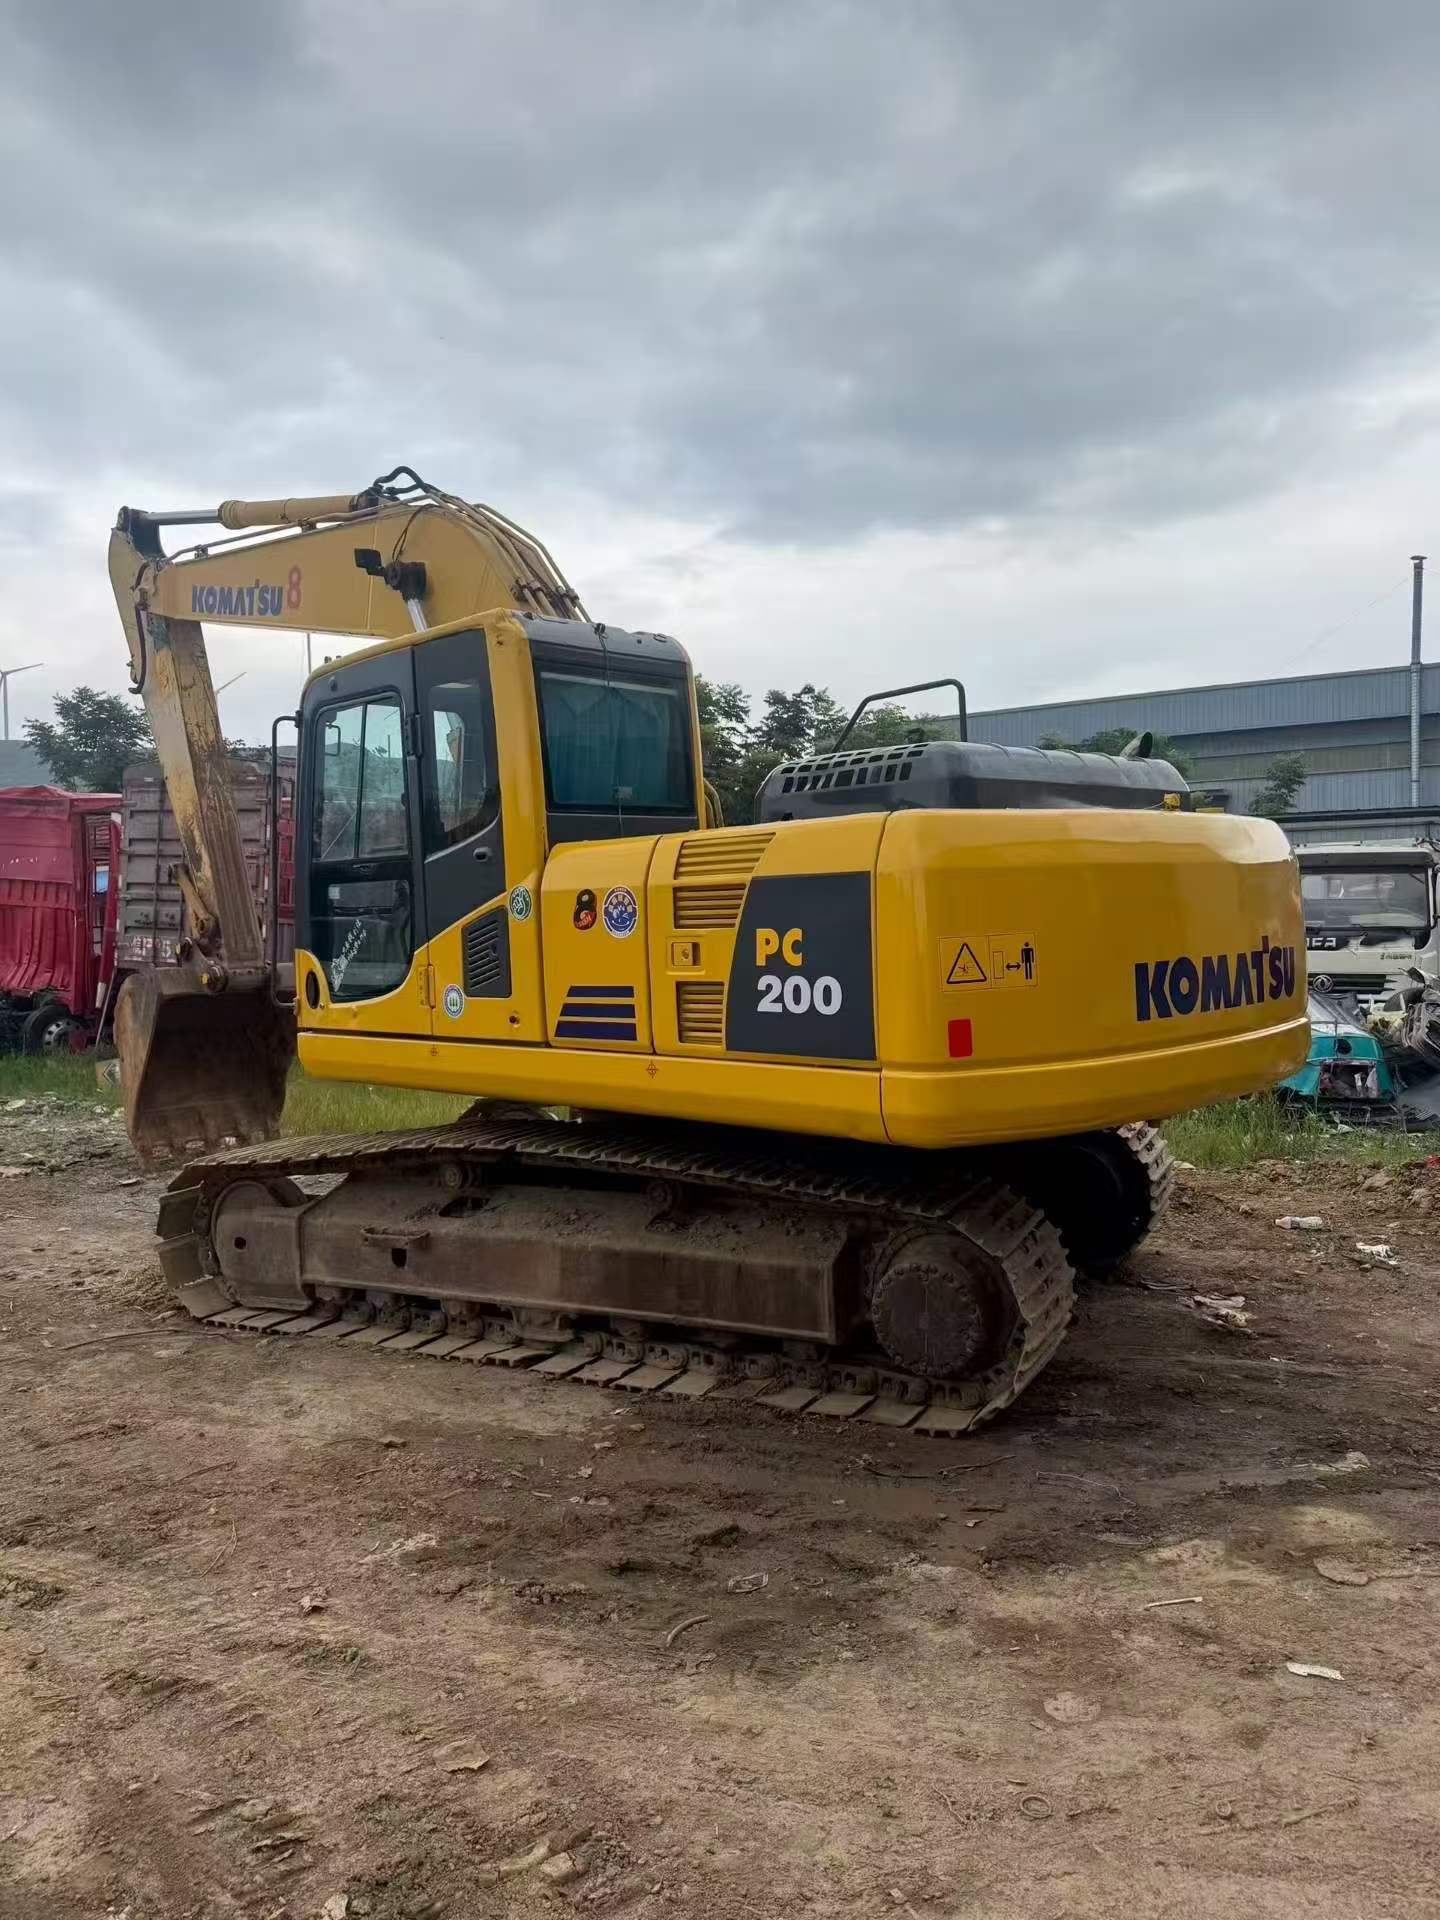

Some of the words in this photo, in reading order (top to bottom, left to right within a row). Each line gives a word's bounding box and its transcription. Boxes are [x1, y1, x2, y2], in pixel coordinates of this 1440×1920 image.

[191, 579, 283, 617] KOMATSU
[286, 564, 302, 610] 8
[755, 927, 803, 967] PC
[757, 974, 843, 1015] 200
[1134, 935, 1296, 1022] KOMATSU
